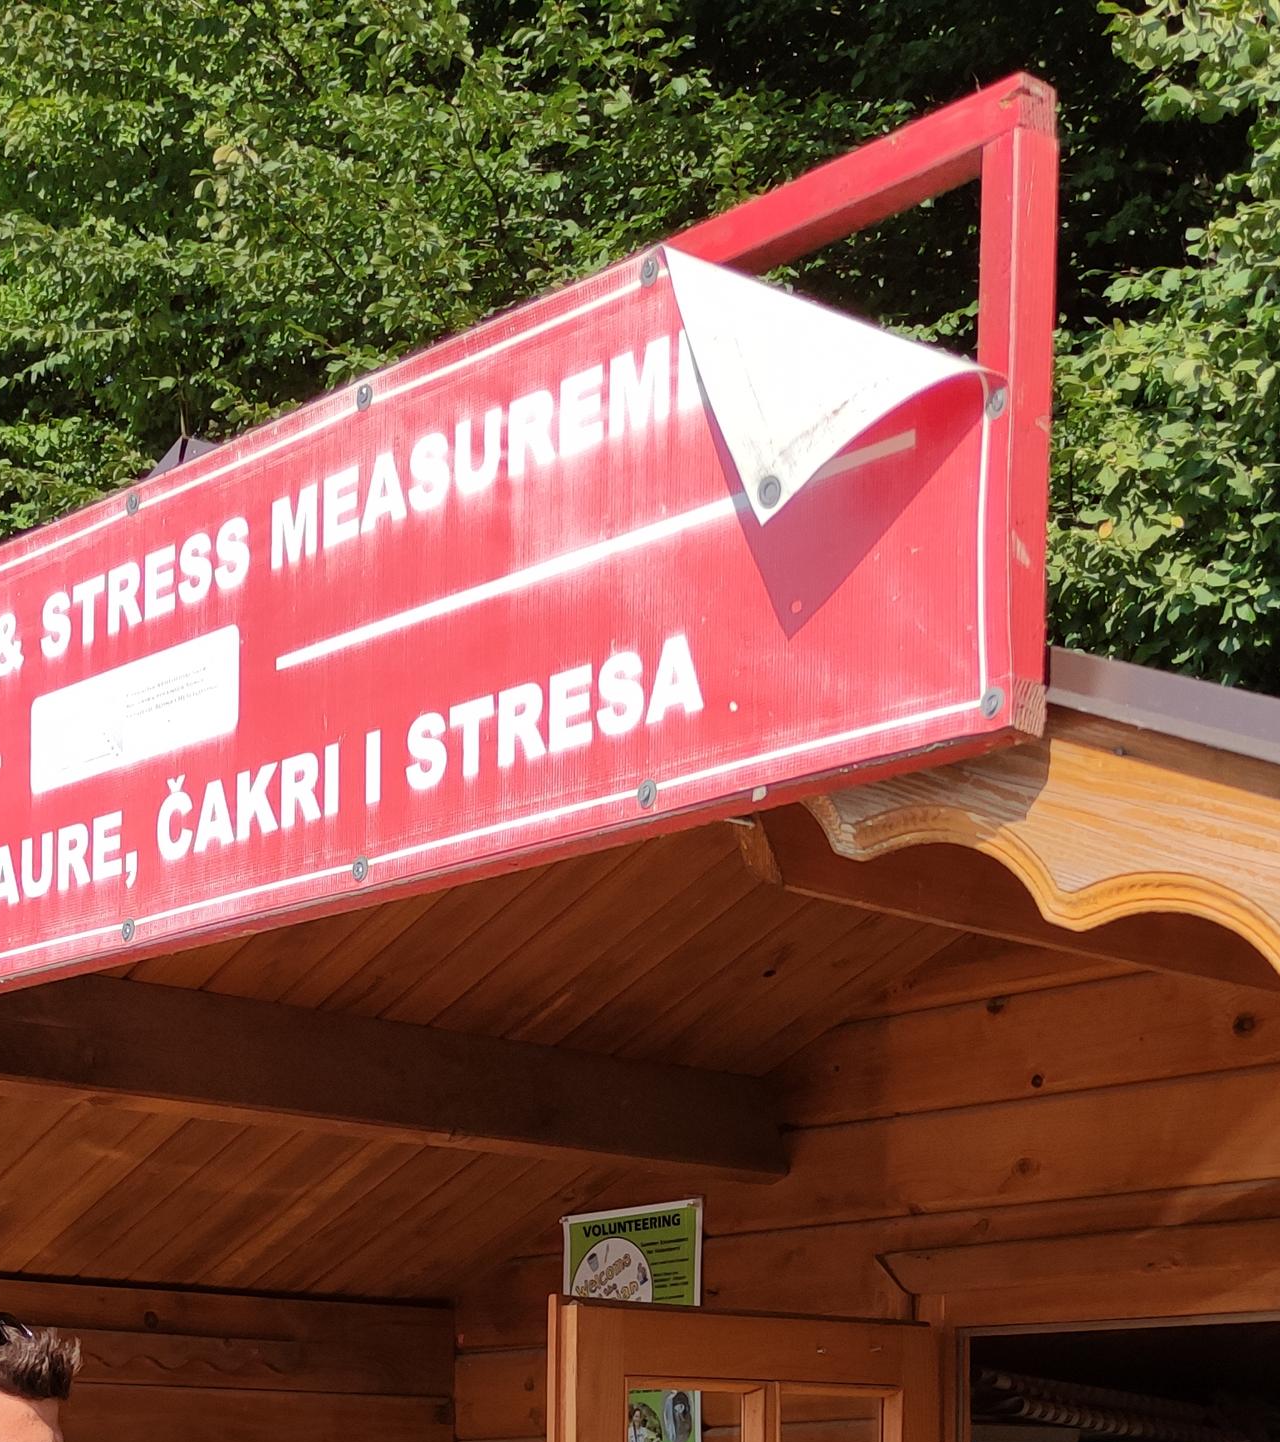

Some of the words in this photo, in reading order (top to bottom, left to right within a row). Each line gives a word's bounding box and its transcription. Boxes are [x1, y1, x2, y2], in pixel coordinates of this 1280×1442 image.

[40, 516, 250, 658] STRESS
[156, 742, 340, 862] ČAKRI
[365, 729, 381, 805] I
[405, 633, 705, 791] STRESA
[583, 1213, 681, 1238] VOLUNTEERING
